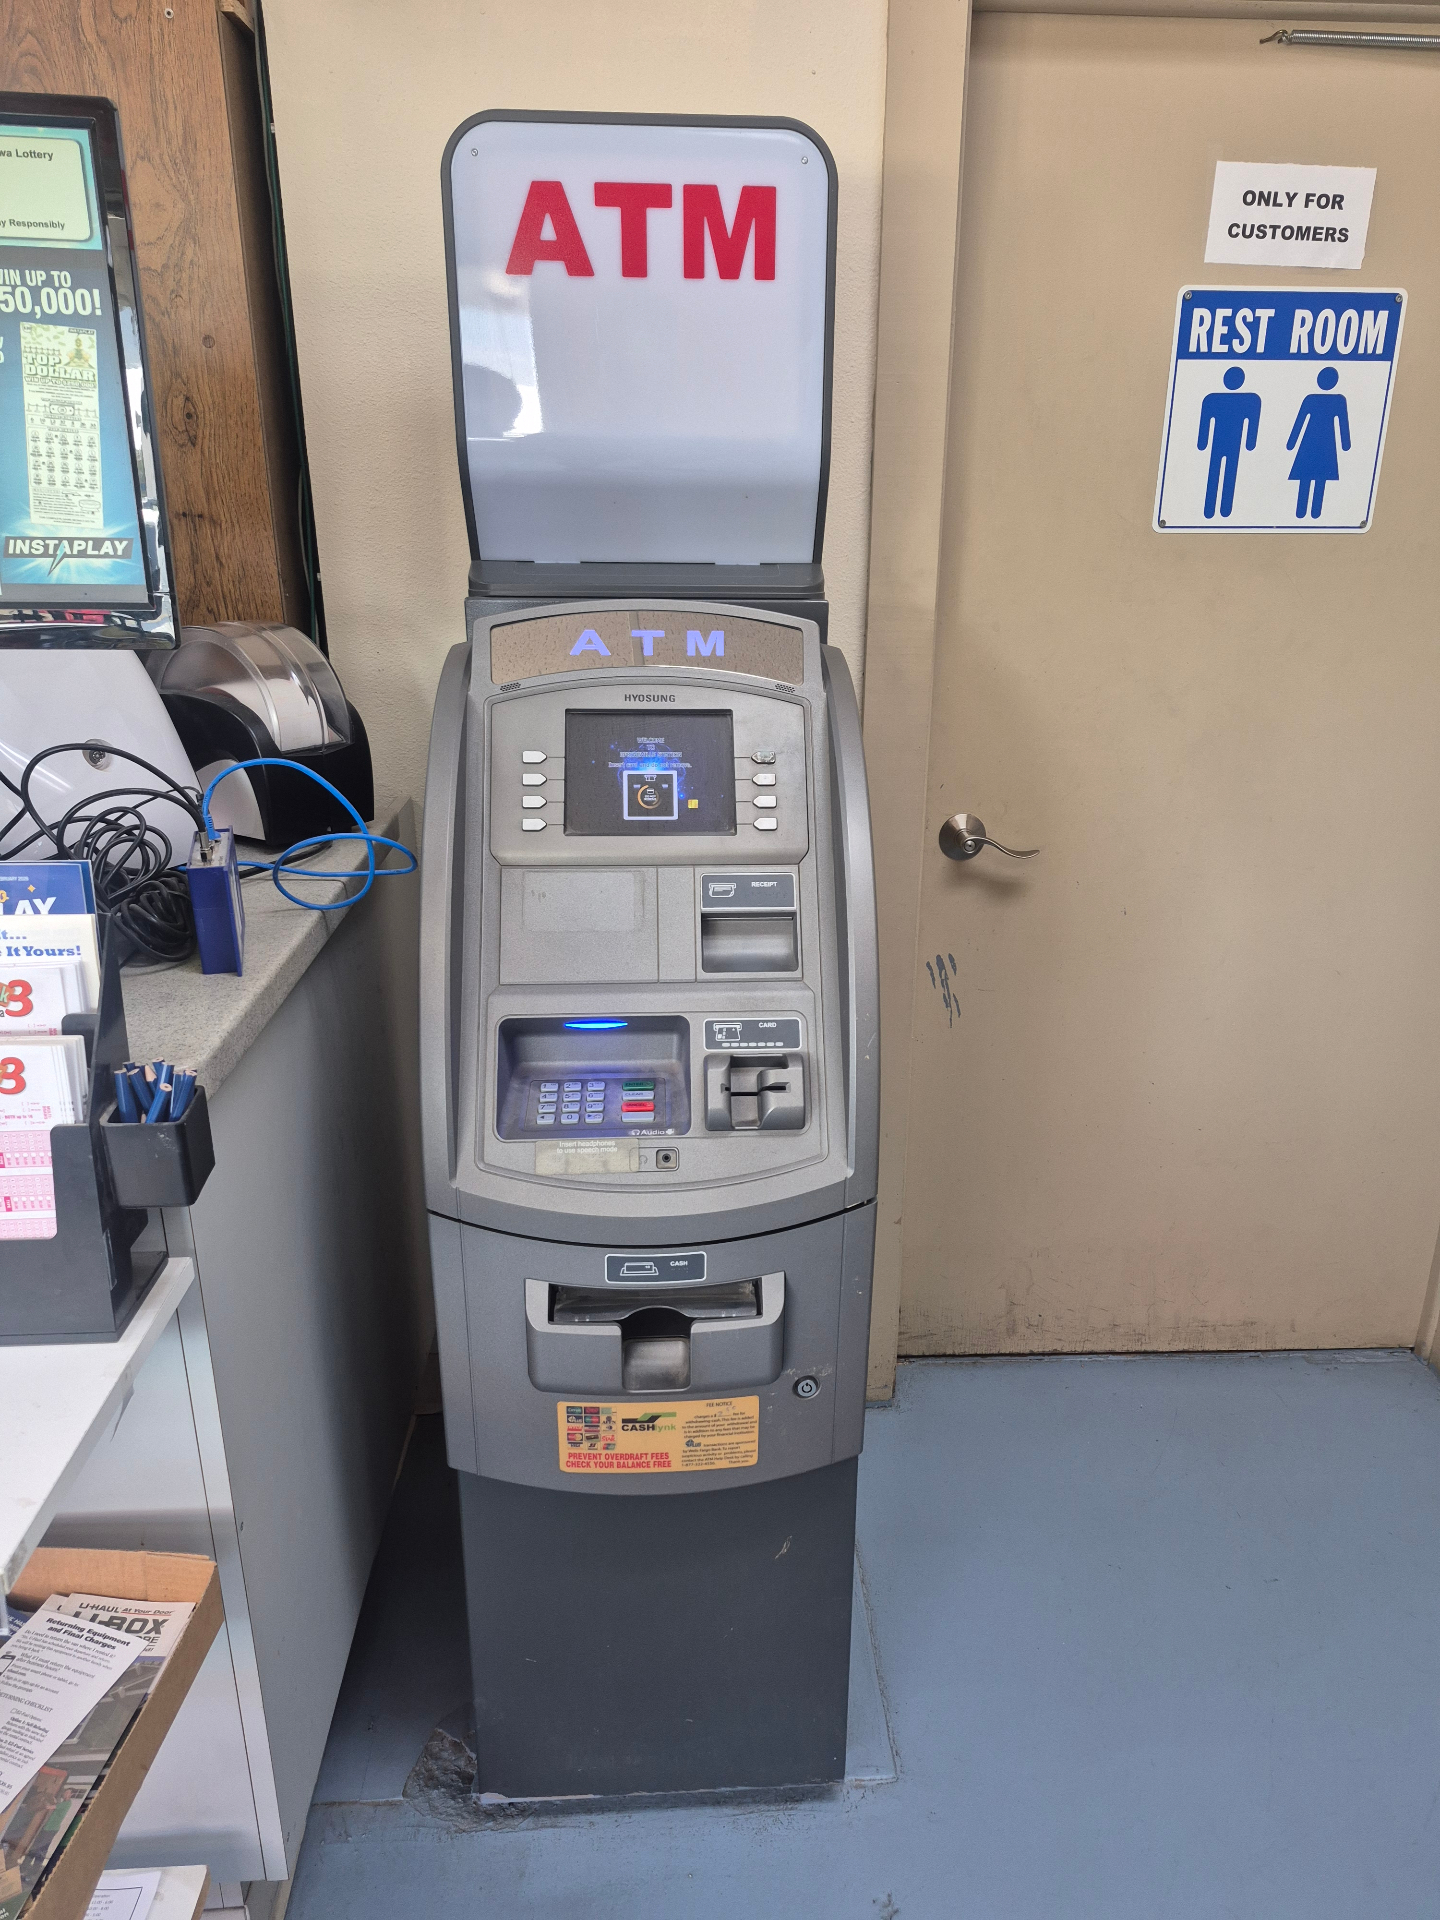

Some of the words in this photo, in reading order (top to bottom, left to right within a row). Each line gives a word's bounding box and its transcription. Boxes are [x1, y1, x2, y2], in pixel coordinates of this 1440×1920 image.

[16, 149, 53, 161] Lottery
[1242, 190, 1298, 208] ONLY
[1304, 193, 1345, 210] FOR
[9, 219, 65, 230] Responsibly
[506, 180, 776, 280] ATM
[1227, 222, 1350, 242] CUSTOMERS
[25, 270, 46, 286] UP
[50, 270, 72, 288] TO
[1188, 307, 1276, 353] REST
[1290, 308, 1390, 354] ROOM
[24, 354, 61, 366] TOP
[24, 364, 96, 382] DOLLAR
[8, 540, 128, 556] INSTAPLAY
[570, 629, 725, 656] ATM
[624, 694, 676, 702] HYOSUNG
[6, 946, 21, 956] It
[22, 946, 81, 956] Yours!
[622, 1424, 676, 1433] CASHlynk
[79, 1602, 120, 1613] U-HAUL
[46, 1618, 85, 1632] Returning
[86, 1626, 131, 1647] Equipment
[63, 1628, 84, 1639] Final
[84, 1635, 116, 1650] Charges
